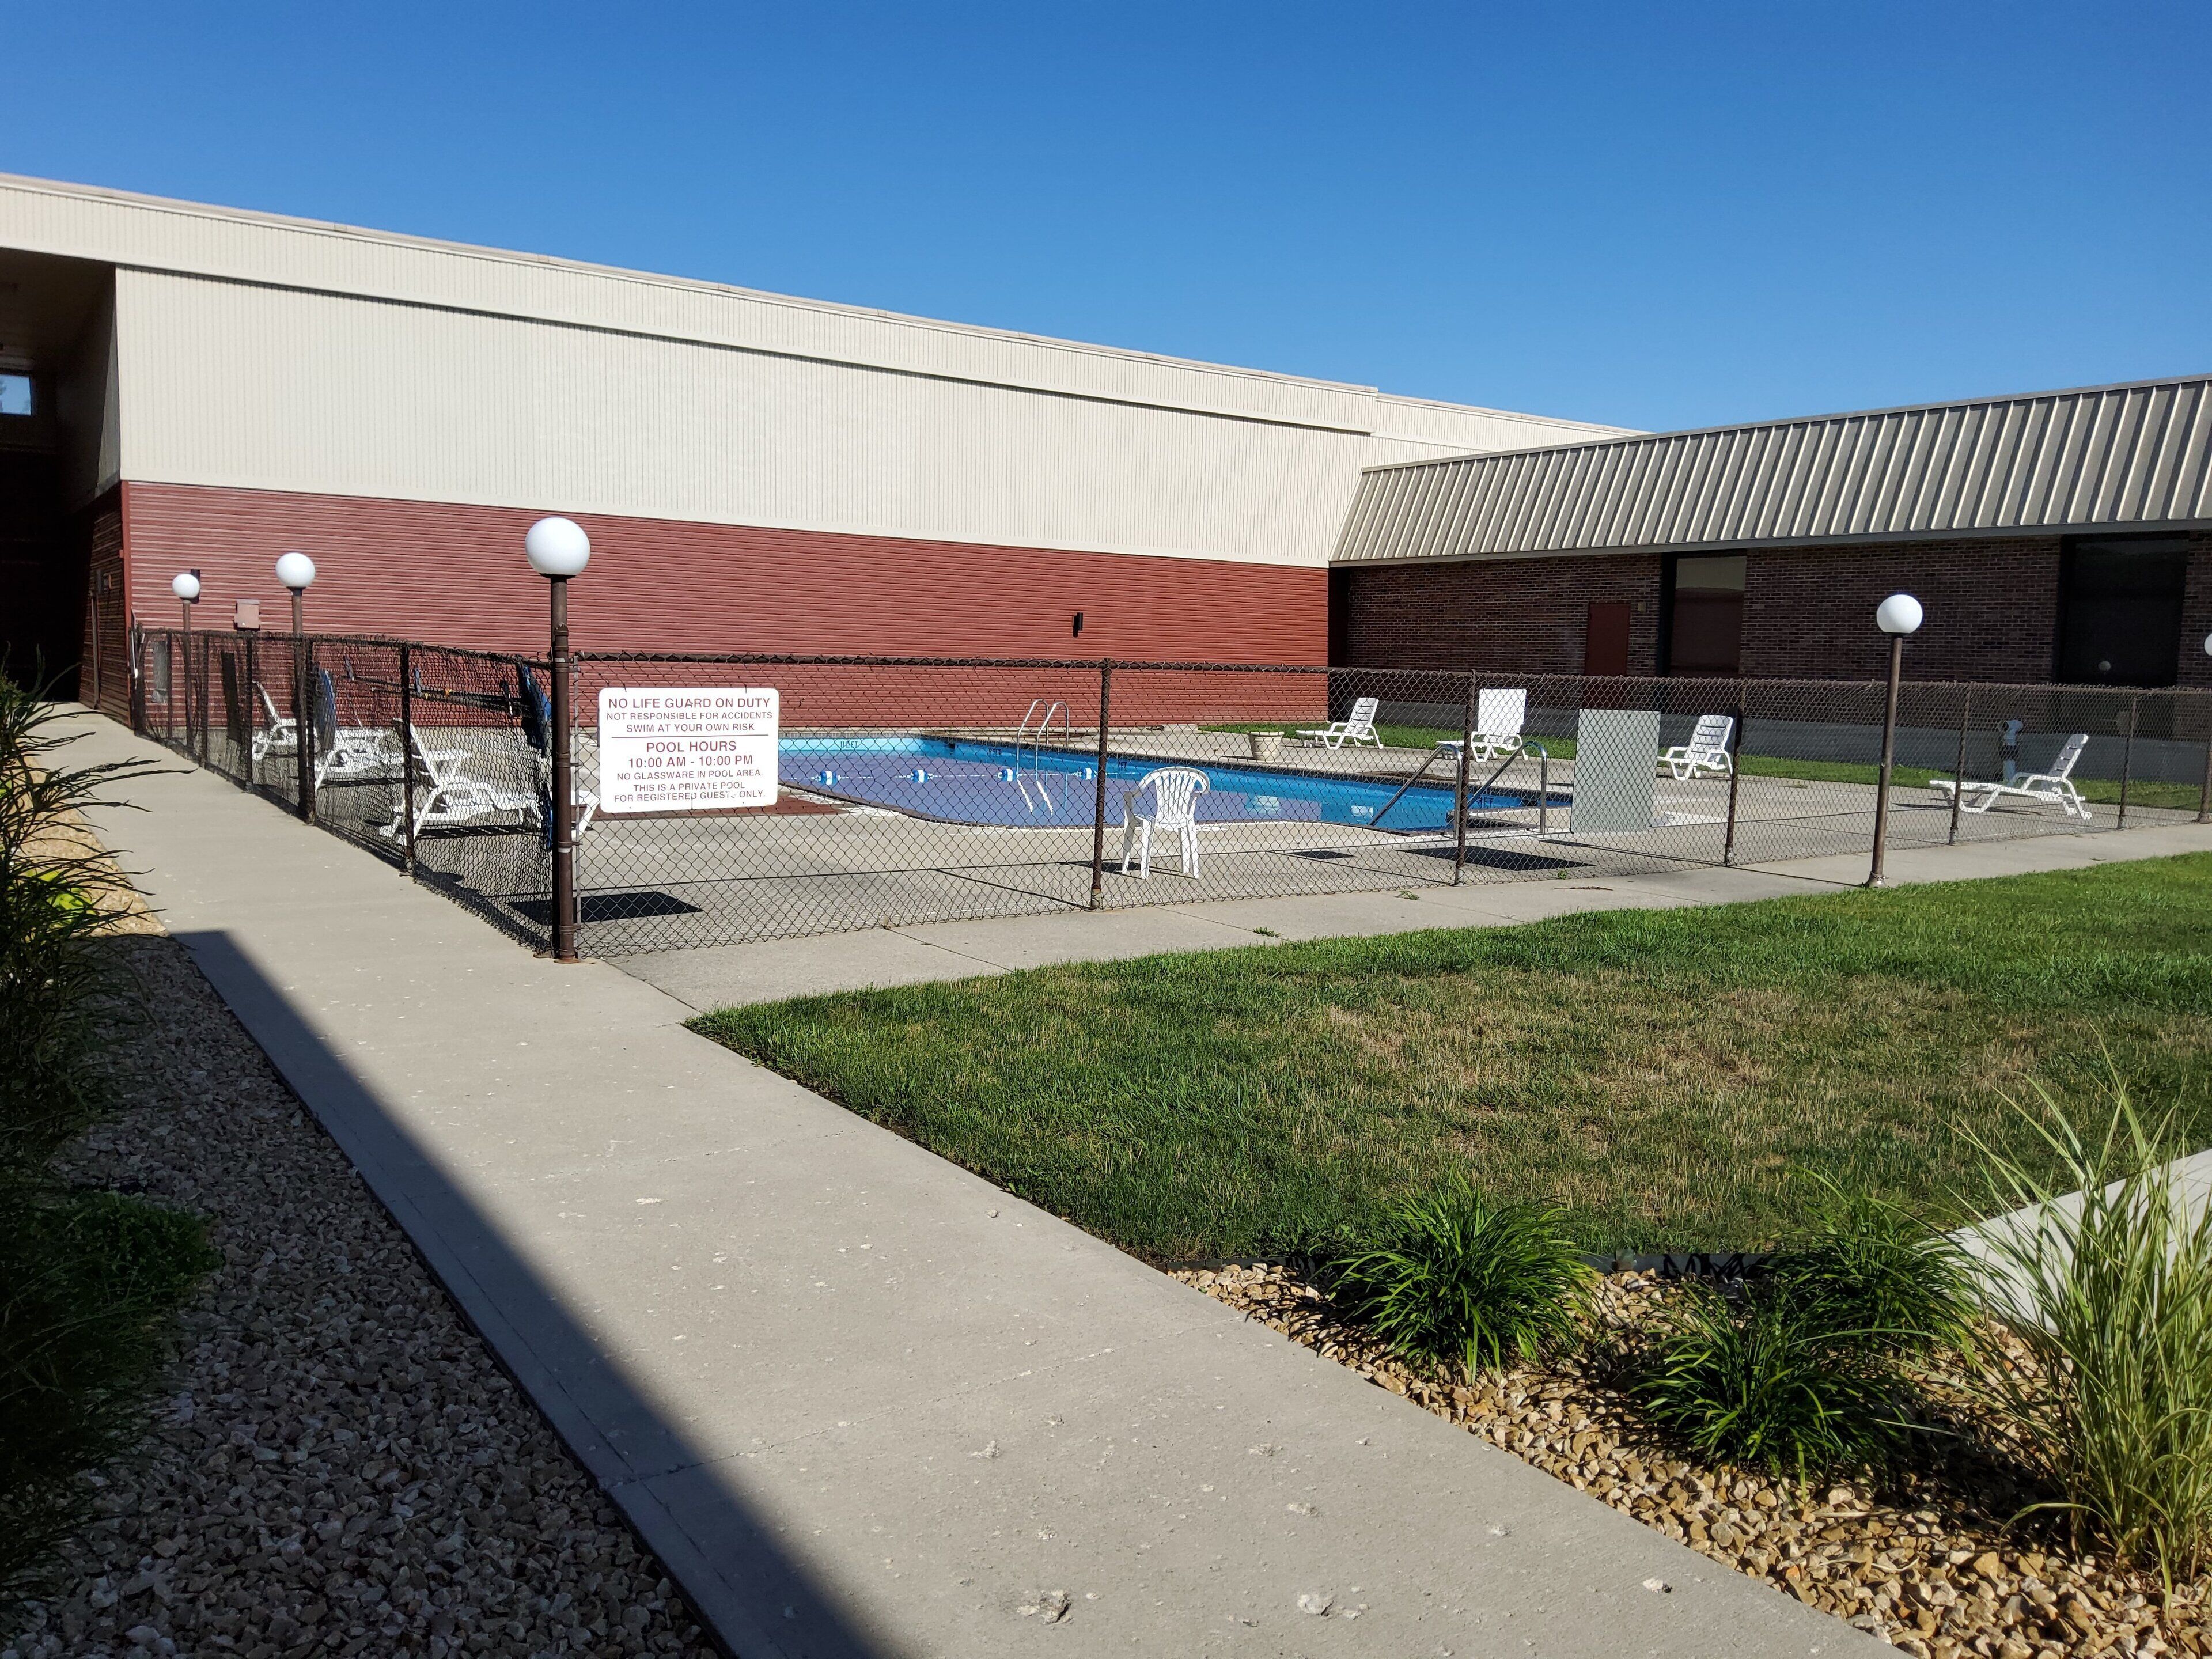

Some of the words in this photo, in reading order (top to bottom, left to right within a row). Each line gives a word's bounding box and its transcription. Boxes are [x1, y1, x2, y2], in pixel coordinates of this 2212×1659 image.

[609, 698, 627, 708] NO
[633, 699, 660, 708] LIFE
[665, 698, 711, 708] GUARD
[716, 698, 733, 707] ON
[738, 698, 770, 707] DUTY
[647, 742, 684, 752] POOL
[690, 741, 736, 752] HOURS
[629, 757, 662, 768] 10:00
[666, 757, 685, 767] AM
[699, 756, 730, 766] 10:00
[735, 755, 752, 765] PM
[634, 771, 694, 779] GLASSWARE
[679, 782, 717, 790] PRIVATE
[721, 782, 745, 790] POOL
[637, 793, 696, 801] REGISTERED
